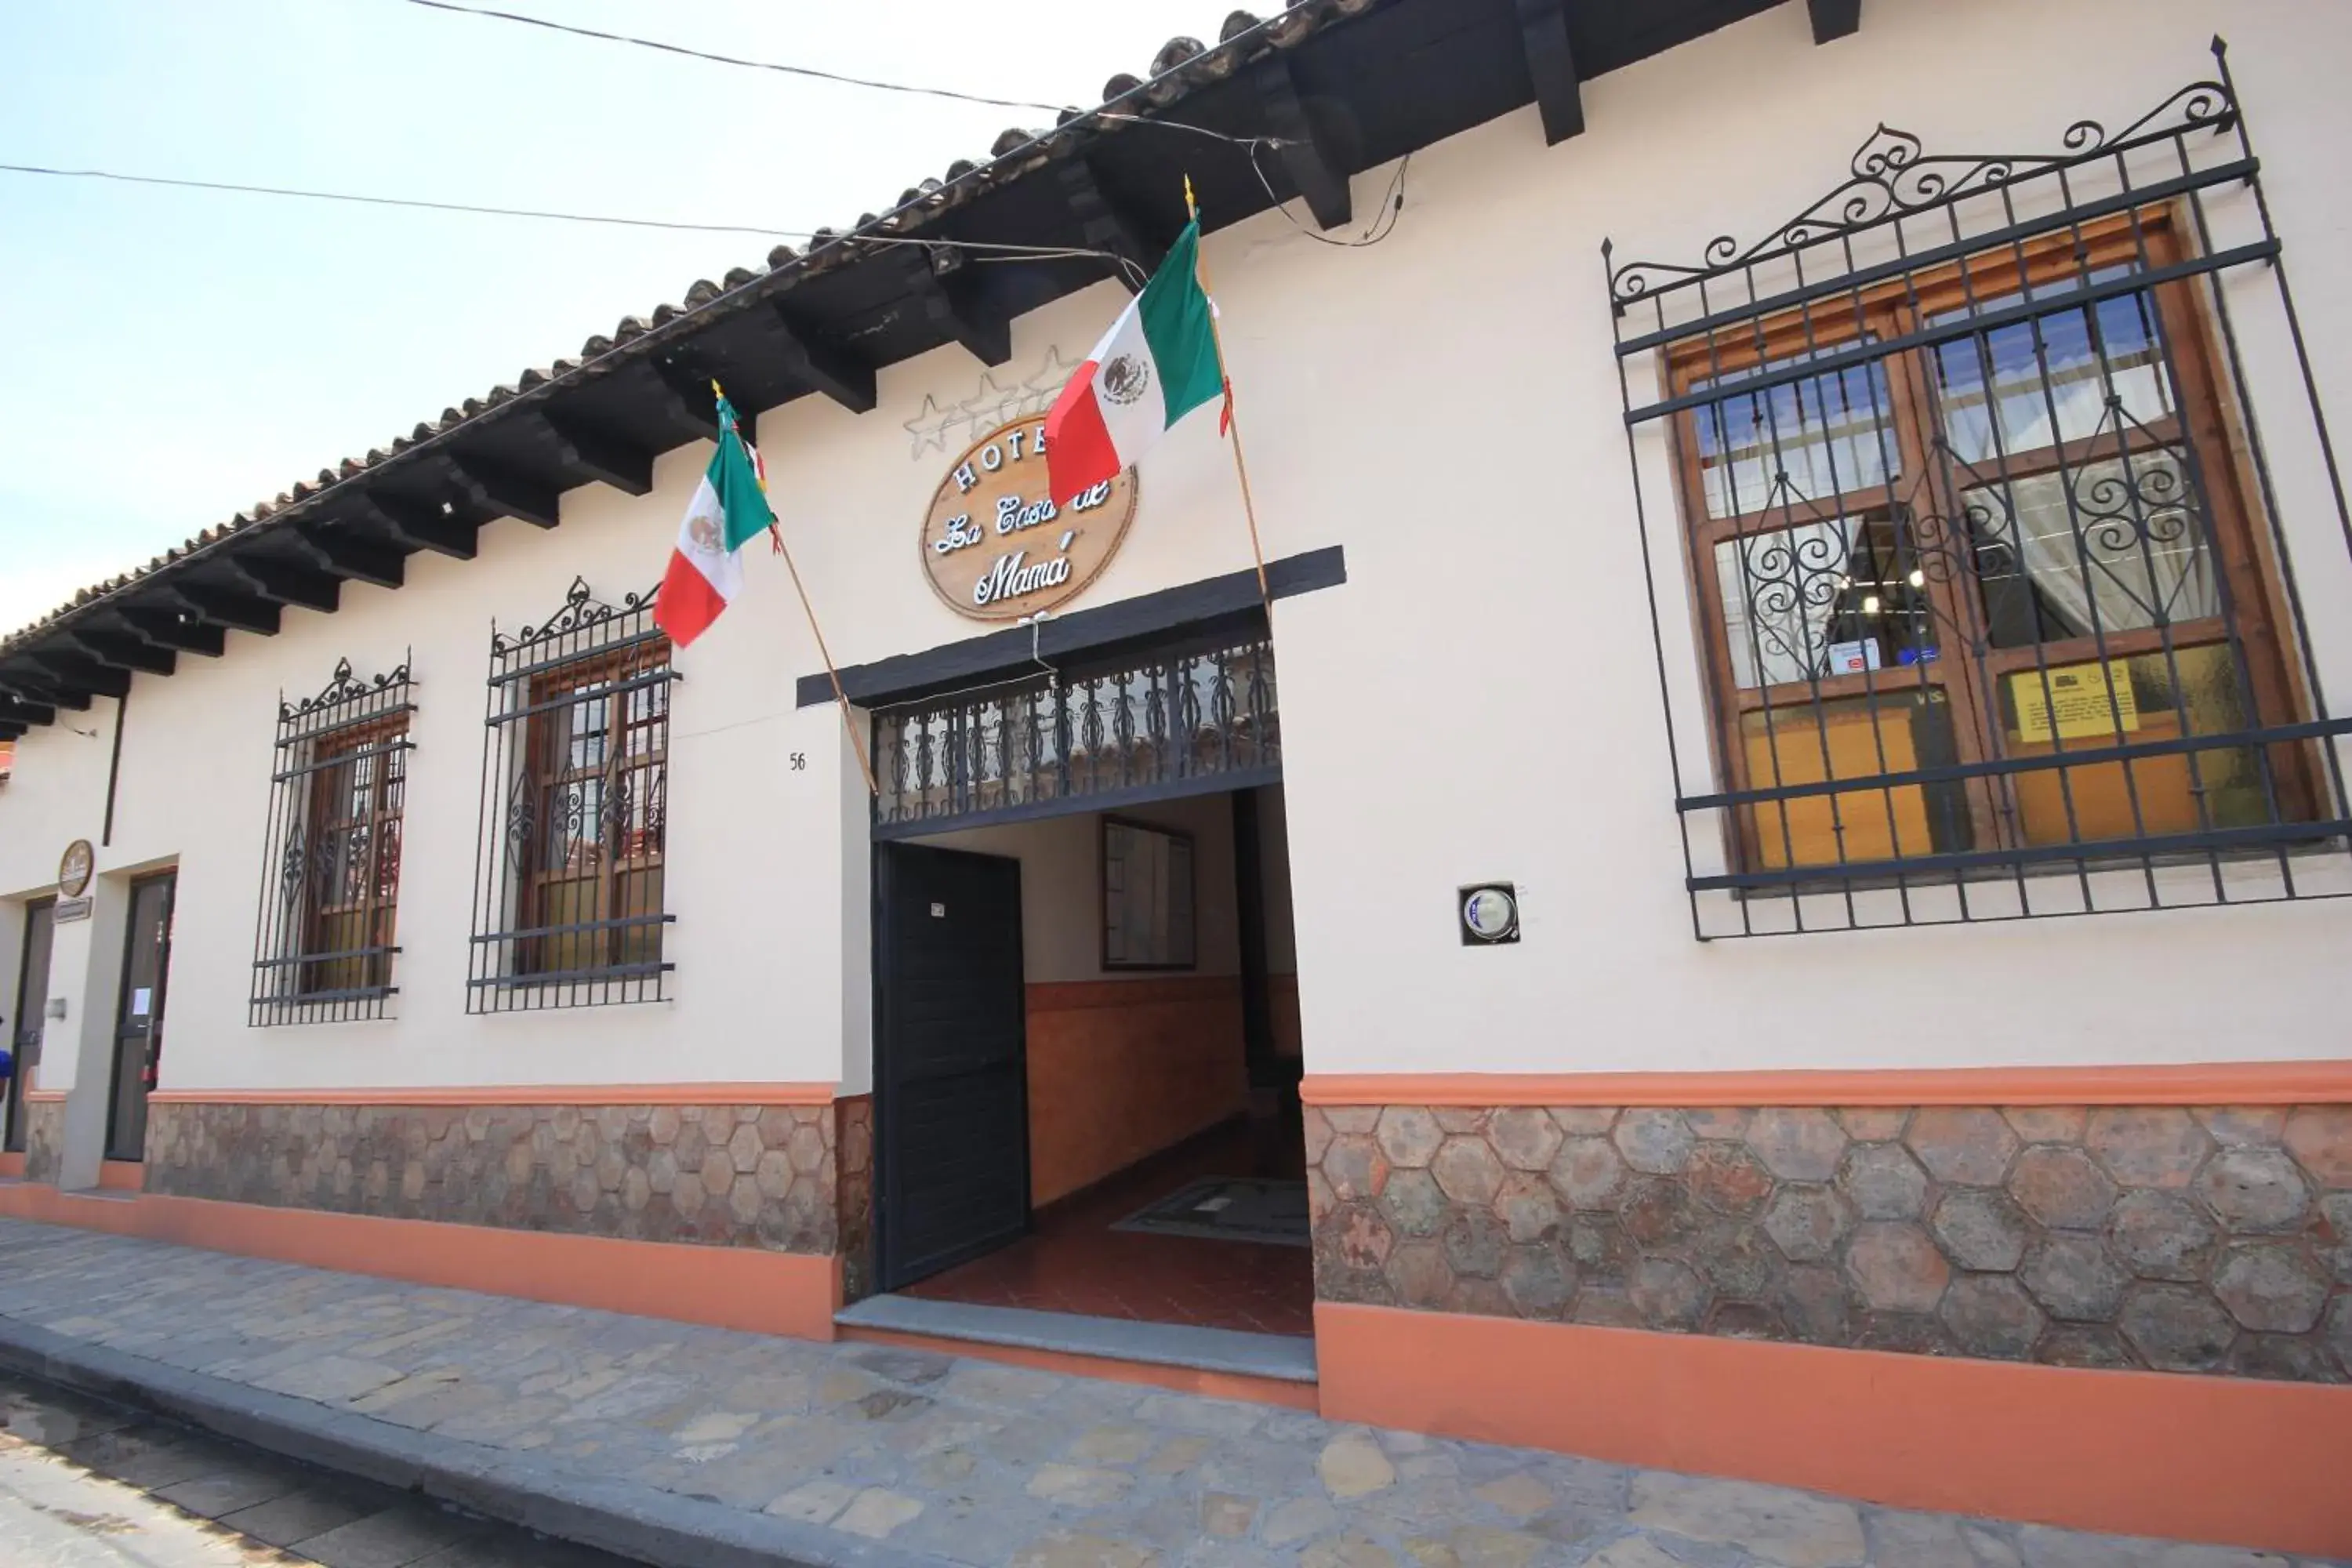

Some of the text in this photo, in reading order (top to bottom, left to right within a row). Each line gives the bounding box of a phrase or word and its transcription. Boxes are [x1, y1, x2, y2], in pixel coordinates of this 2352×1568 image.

[954, 427, 1046, 492] HOTE
[935, 514, 982, 554] La
[996, 496, 1056, 534] Casa
[975, 530, 1071, 604] Mamá
[789, 752, 805, 771] 56
